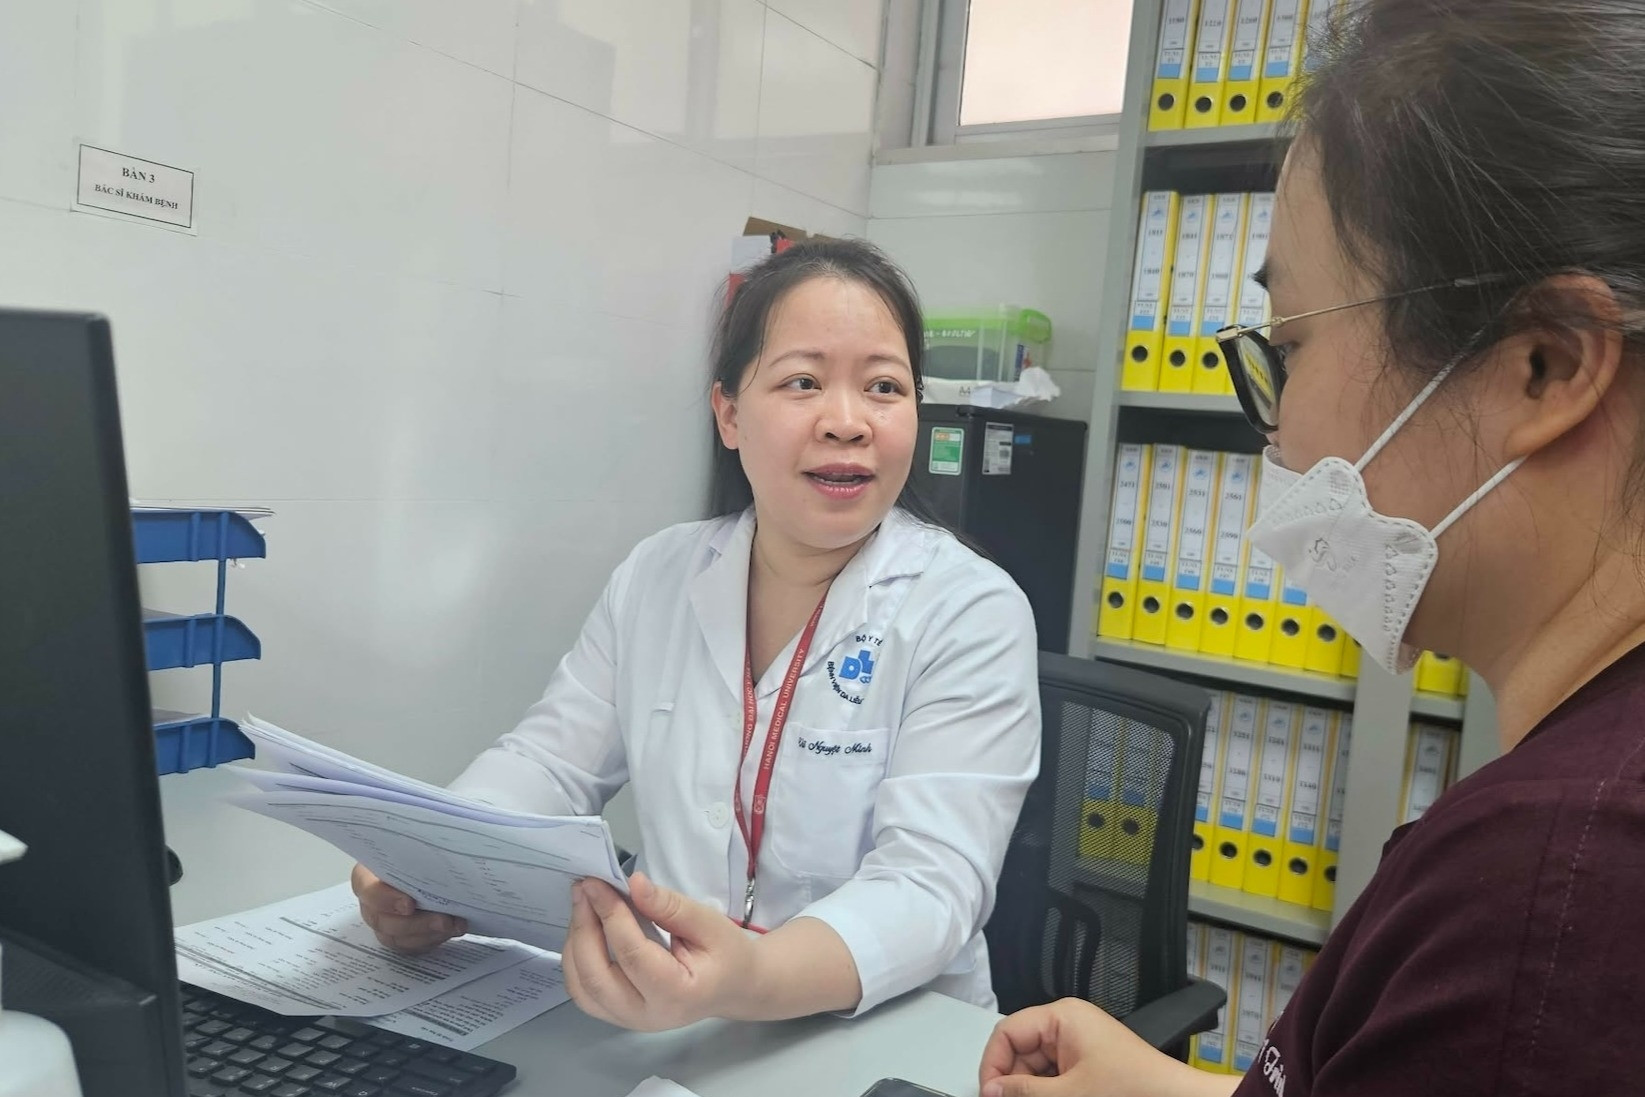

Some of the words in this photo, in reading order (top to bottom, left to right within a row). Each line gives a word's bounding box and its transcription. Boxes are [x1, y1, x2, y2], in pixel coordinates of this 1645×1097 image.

[122, 166, 146, 181] BÀN
[149, 174, 156, 184] 3
[95, 184, 114, 195] BÁC
[126, 191, 153, 204] KHÁM
[155, 198, 178, 210] BỆNH
[764, 740, 776, 770] HANOI
[770, 702, 787, 740] MEDICAL
[782, 649, 805, 700] UNIVERSITY
[808, 741, 841, 755] Nguyệt
[844, 743, 873, 754] Minh
